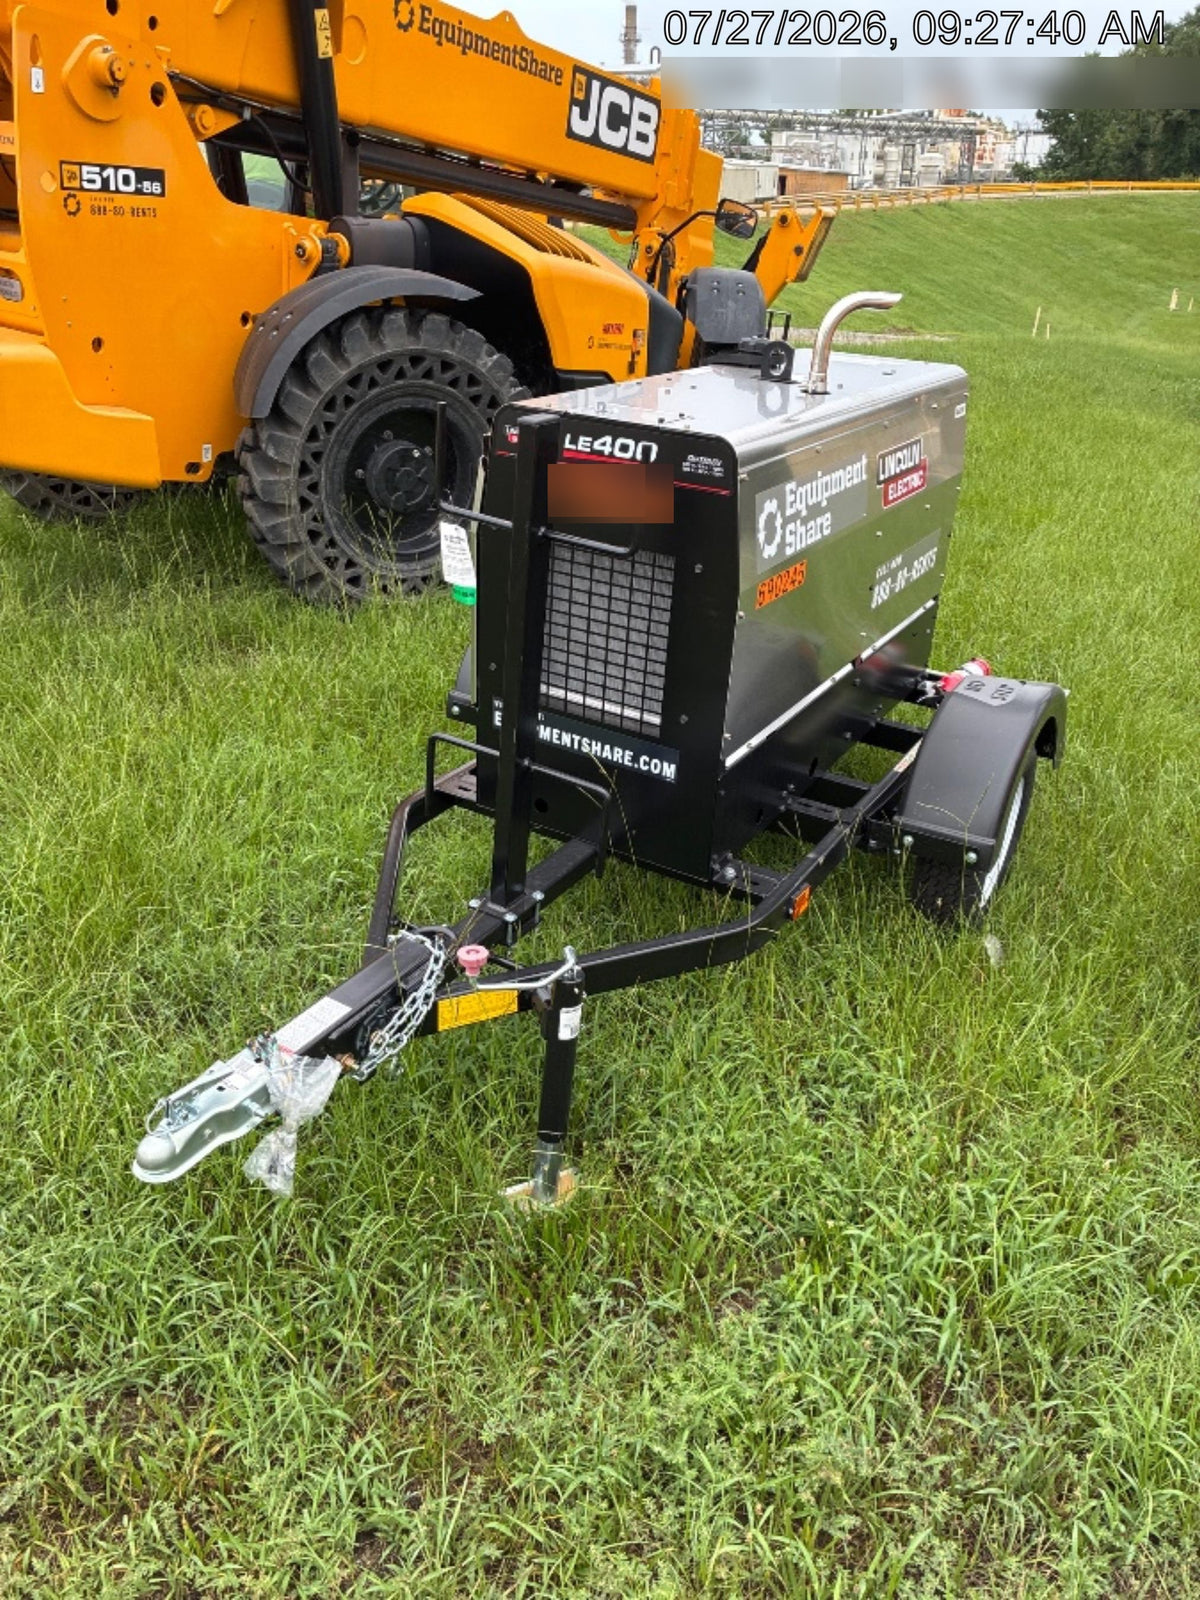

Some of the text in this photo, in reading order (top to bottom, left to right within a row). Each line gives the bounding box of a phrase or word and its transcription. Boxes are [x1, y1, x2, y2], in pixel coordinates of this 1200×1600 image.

[418, 4, 563, 86] EquipmentShare
[570, 78, 659, 157] JCB
[81, 165, 162, 194] 510-56
[880, 441, 921, 481] LINCOLN
[785, 453, 868, 517] Equipment
[888, 469, 924, 501] ELECTRIC
[785, 512, 831, 556] Share
